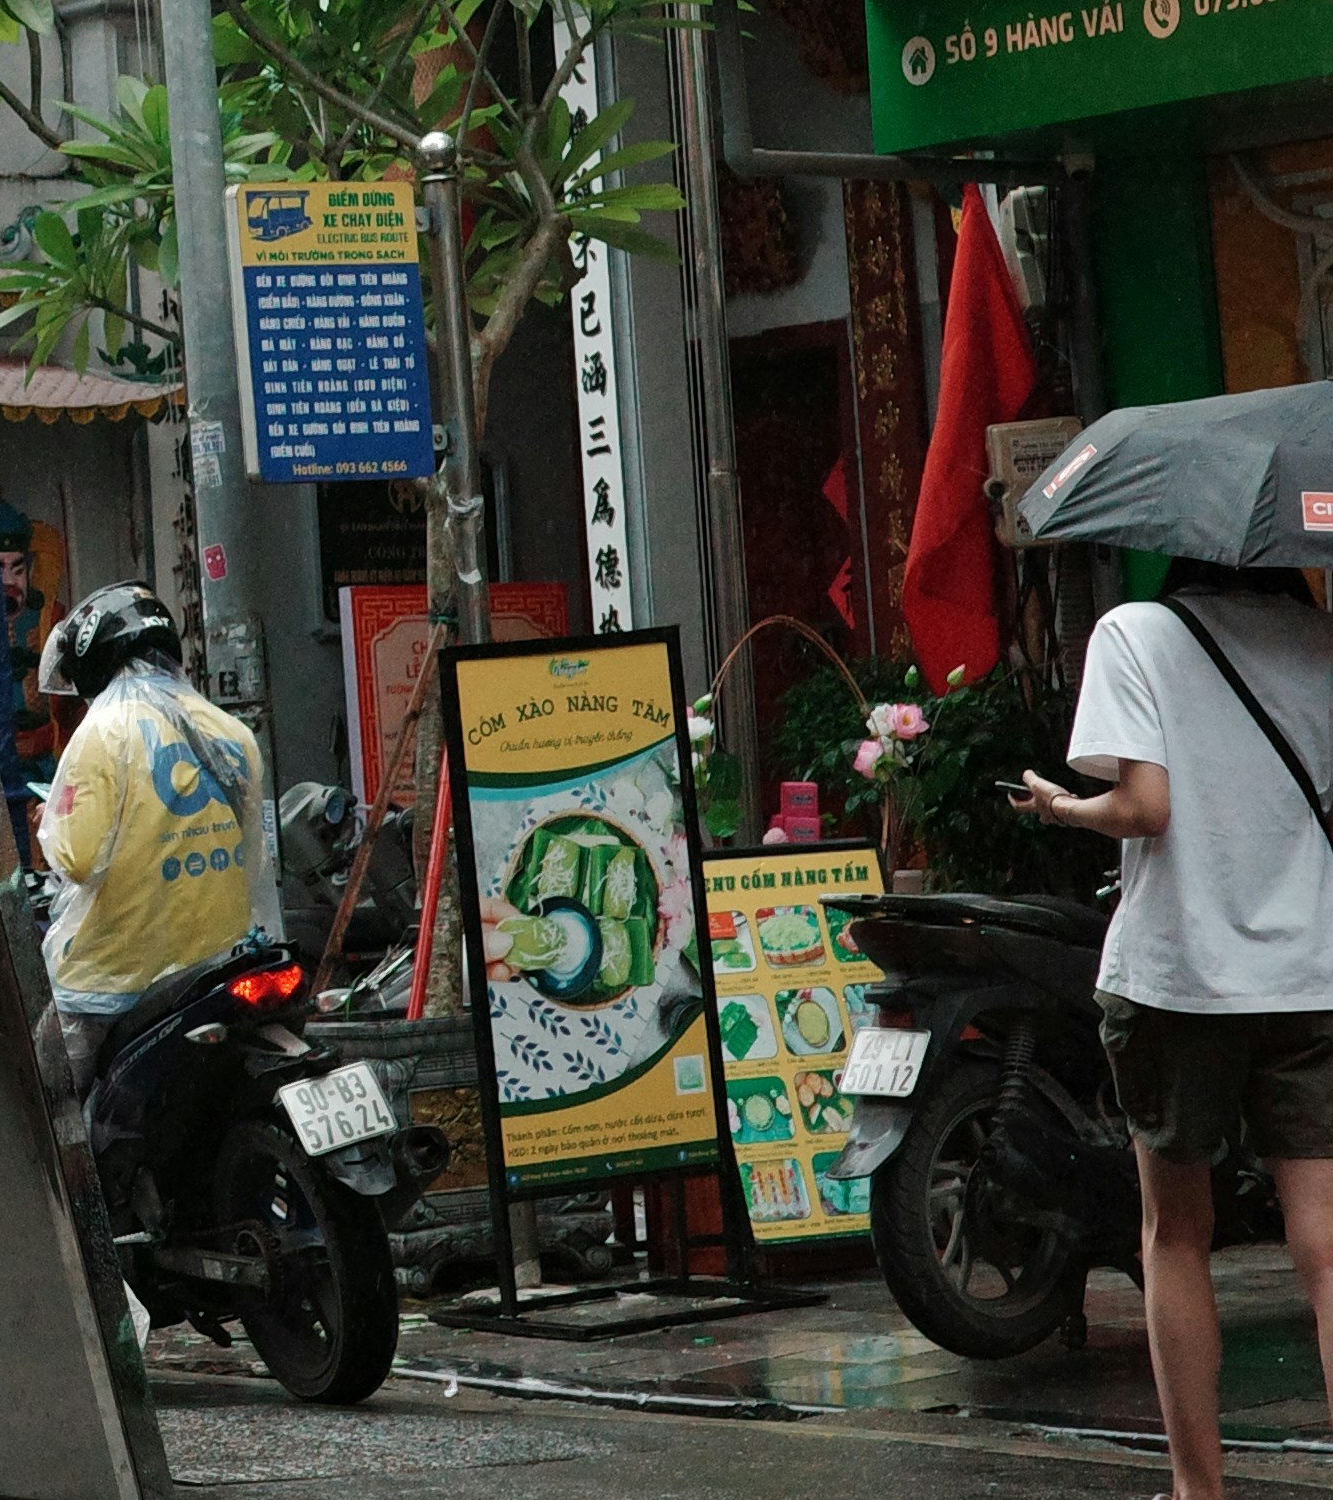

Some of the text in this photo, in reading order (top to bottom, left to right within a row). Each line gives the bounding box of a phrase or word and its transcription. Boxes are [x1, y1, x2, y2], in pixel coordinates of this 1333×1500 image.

[945, 18, 976, 64] SỐ
[984, 28, 998, 58] 9
[1006, 13, 1074, 52] HÀNG
[323, 214, 337, 227] XE
[317, 232, 408, 244] ELECTRIC BUS ROUTE
[337, 250, 373, 260] TRONG
[336, 463, 356, 474] 093
[358, 462, 377, 472] 662
[381, 461, 407, 471] 4566
[516, 696, 555, 722] XÀO
[567, 691, 618, 713] NÀNG
[847, 1063, 913, 1092] 501.12
[295, 1071, 367, 1115] 90-B3
[301, 1099, 389, 1150] 576.24
